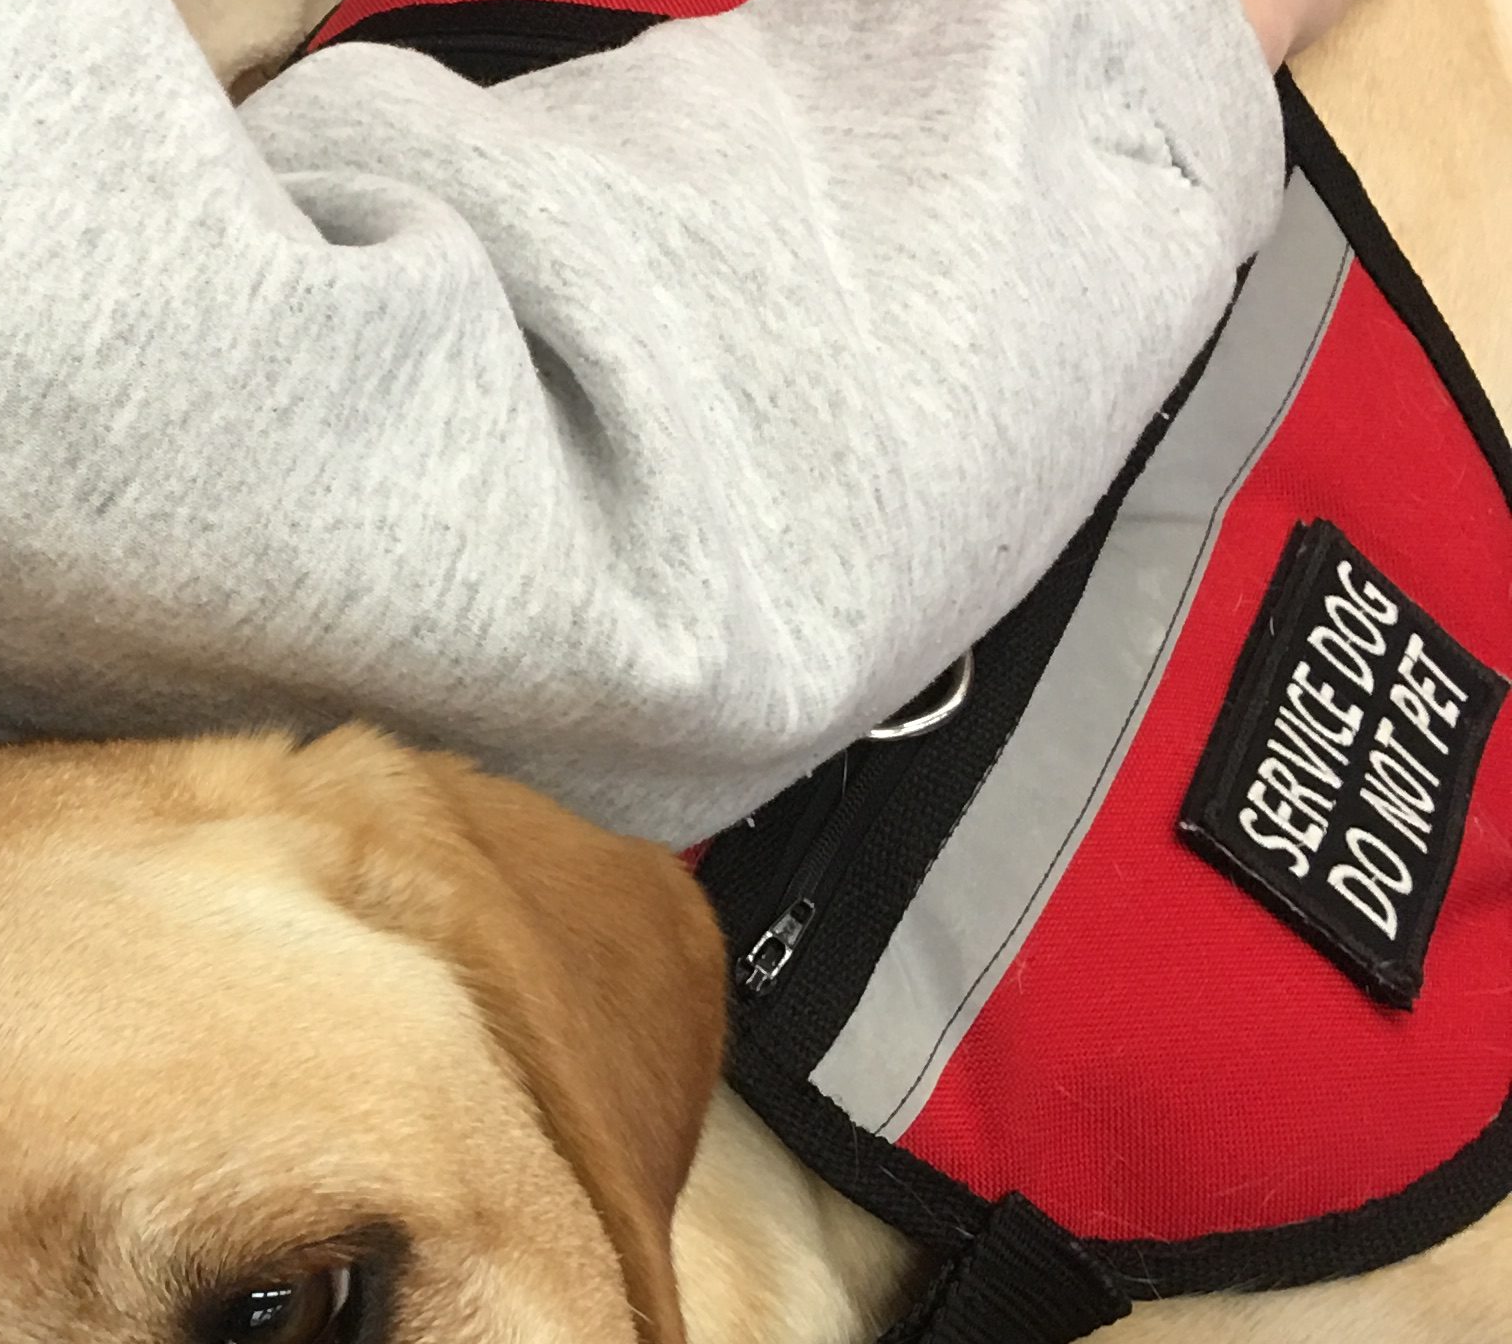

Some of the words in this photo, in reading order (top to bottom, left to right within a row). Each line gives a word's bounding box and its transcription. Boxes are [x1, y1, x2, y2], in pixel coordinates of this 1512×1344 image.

[1239, 661, 1365, 878] SERVICE
[1307, 560, 1399, 695] DOG
[1390, 632, 1469, 755] PET
[1360, 717, 1441, 855] NOT
[1327, 827, 1414, 941] DO
